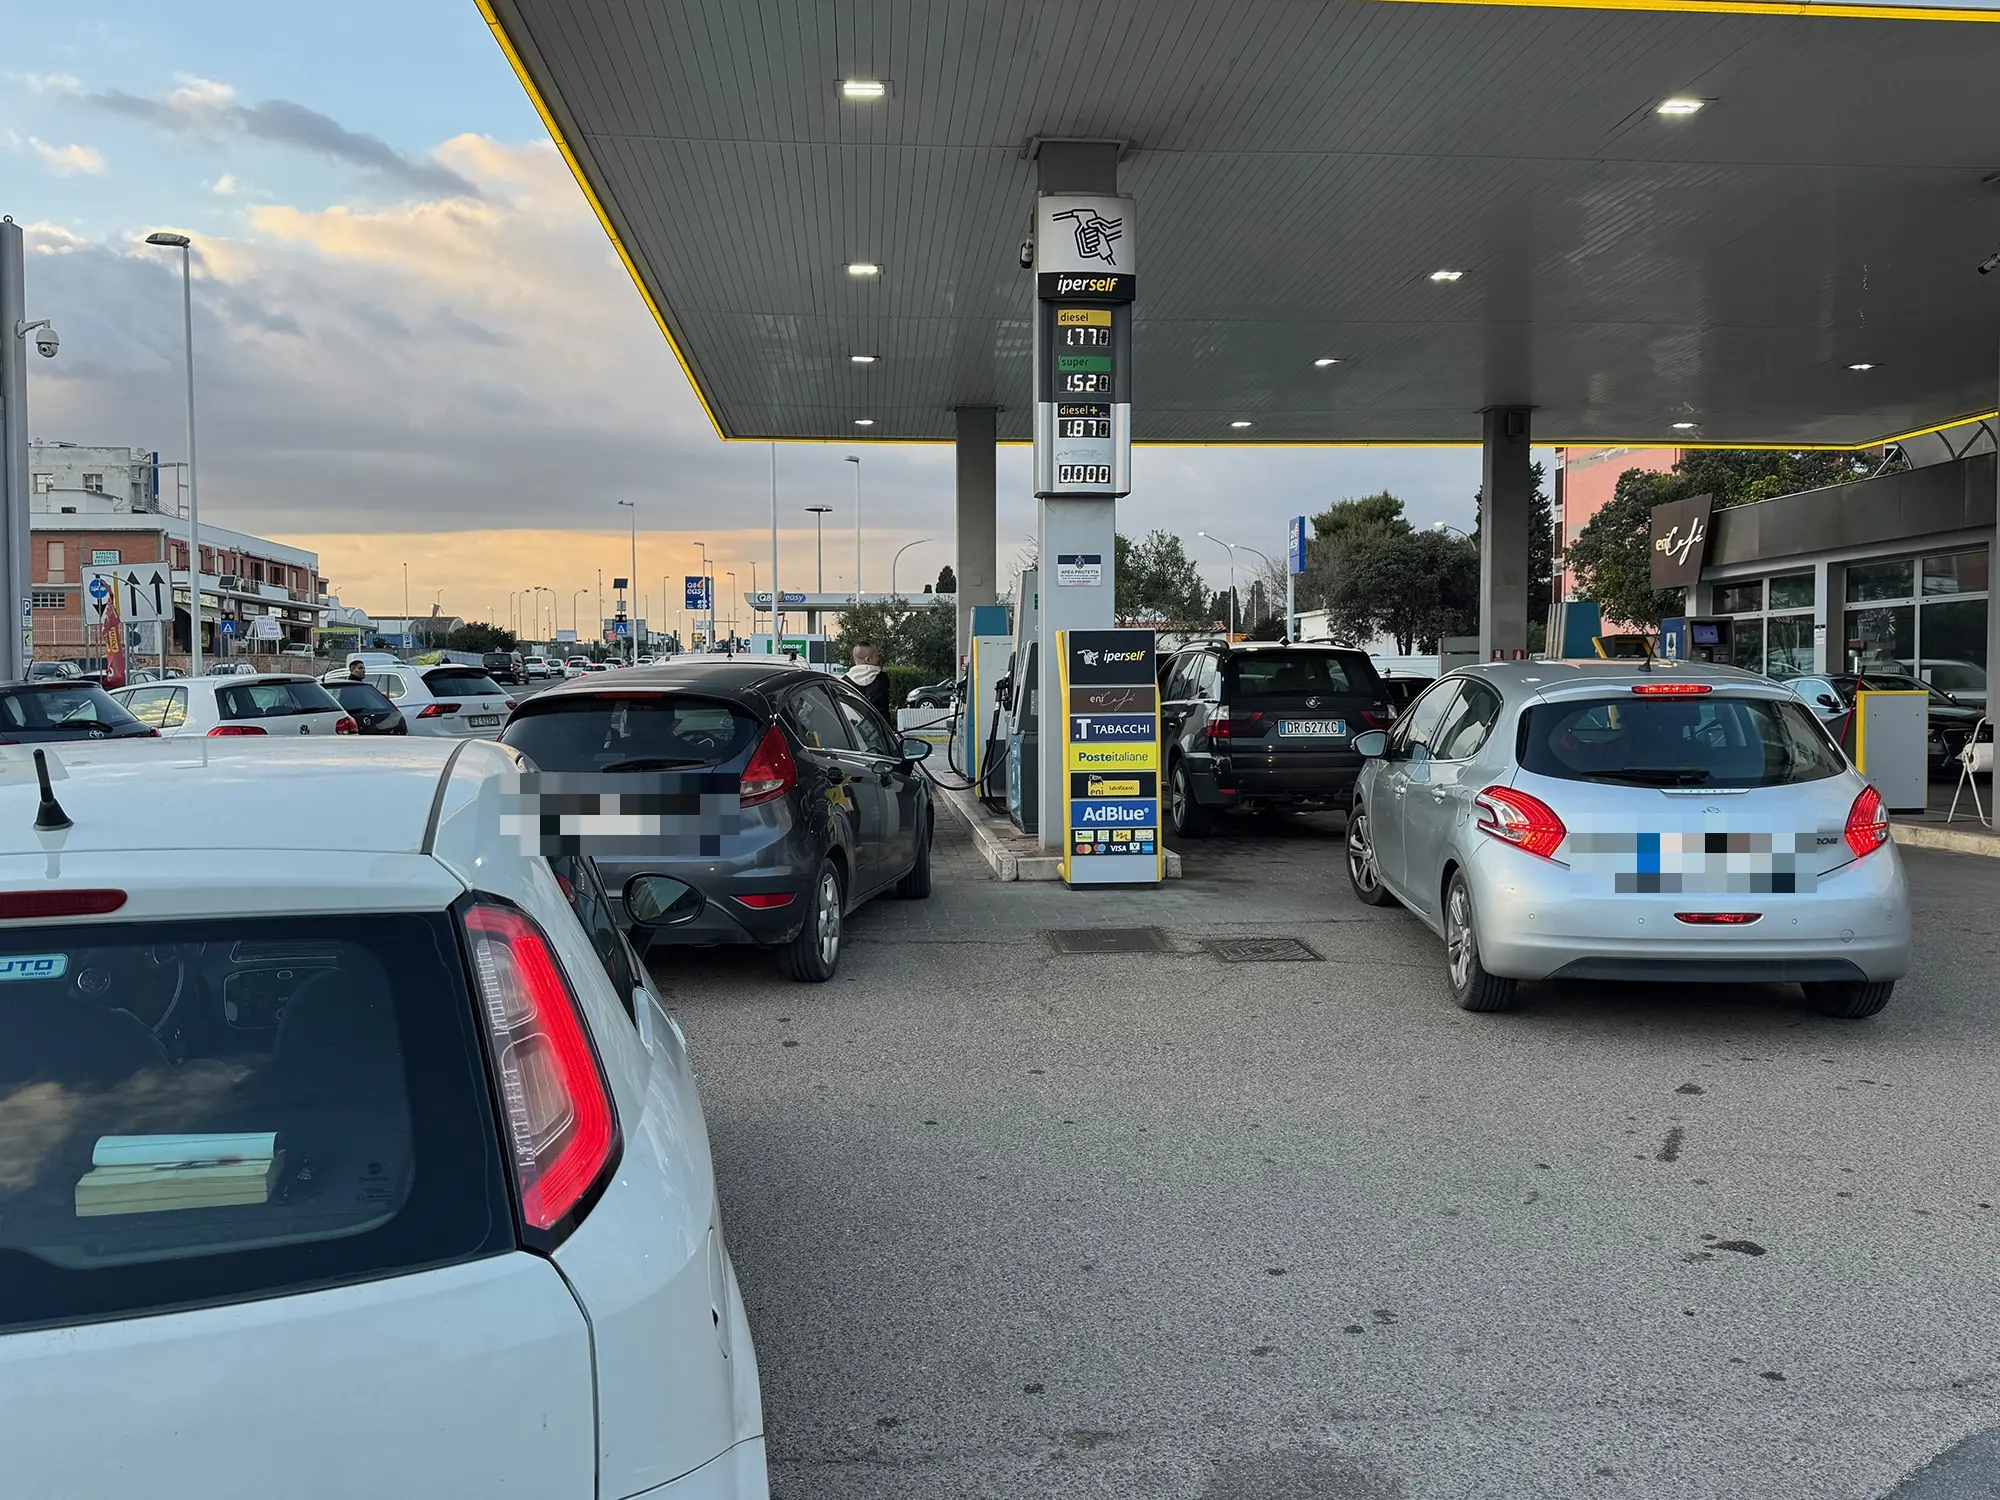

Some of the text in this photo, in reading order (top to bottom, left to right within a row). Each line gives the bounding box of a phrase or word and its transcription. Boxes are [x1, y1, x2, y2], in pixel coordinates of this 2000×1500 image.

[1057, 275, 1118, 294] iperself
[1060, 312, 1088, 322] diesel
[1061, 359, 1089, 367] super
[1066, 374, 1109, 392] 1.520
[1060, 405, 1088, 415] diesel
[1066, 420, 1109, 437] 1.870
[1061, 466, 1109, 482] 0.000
[759, 594, 804, 603] Q8 easy
[25, 601, 30, 615] P
[1103, 650, 1146, 663] iperself
[1093, 724, 1150, 734] TABACCHI
[1288, 722, 1338, 733] DR 627KC
[1090, 787, 1104, 795] eni
